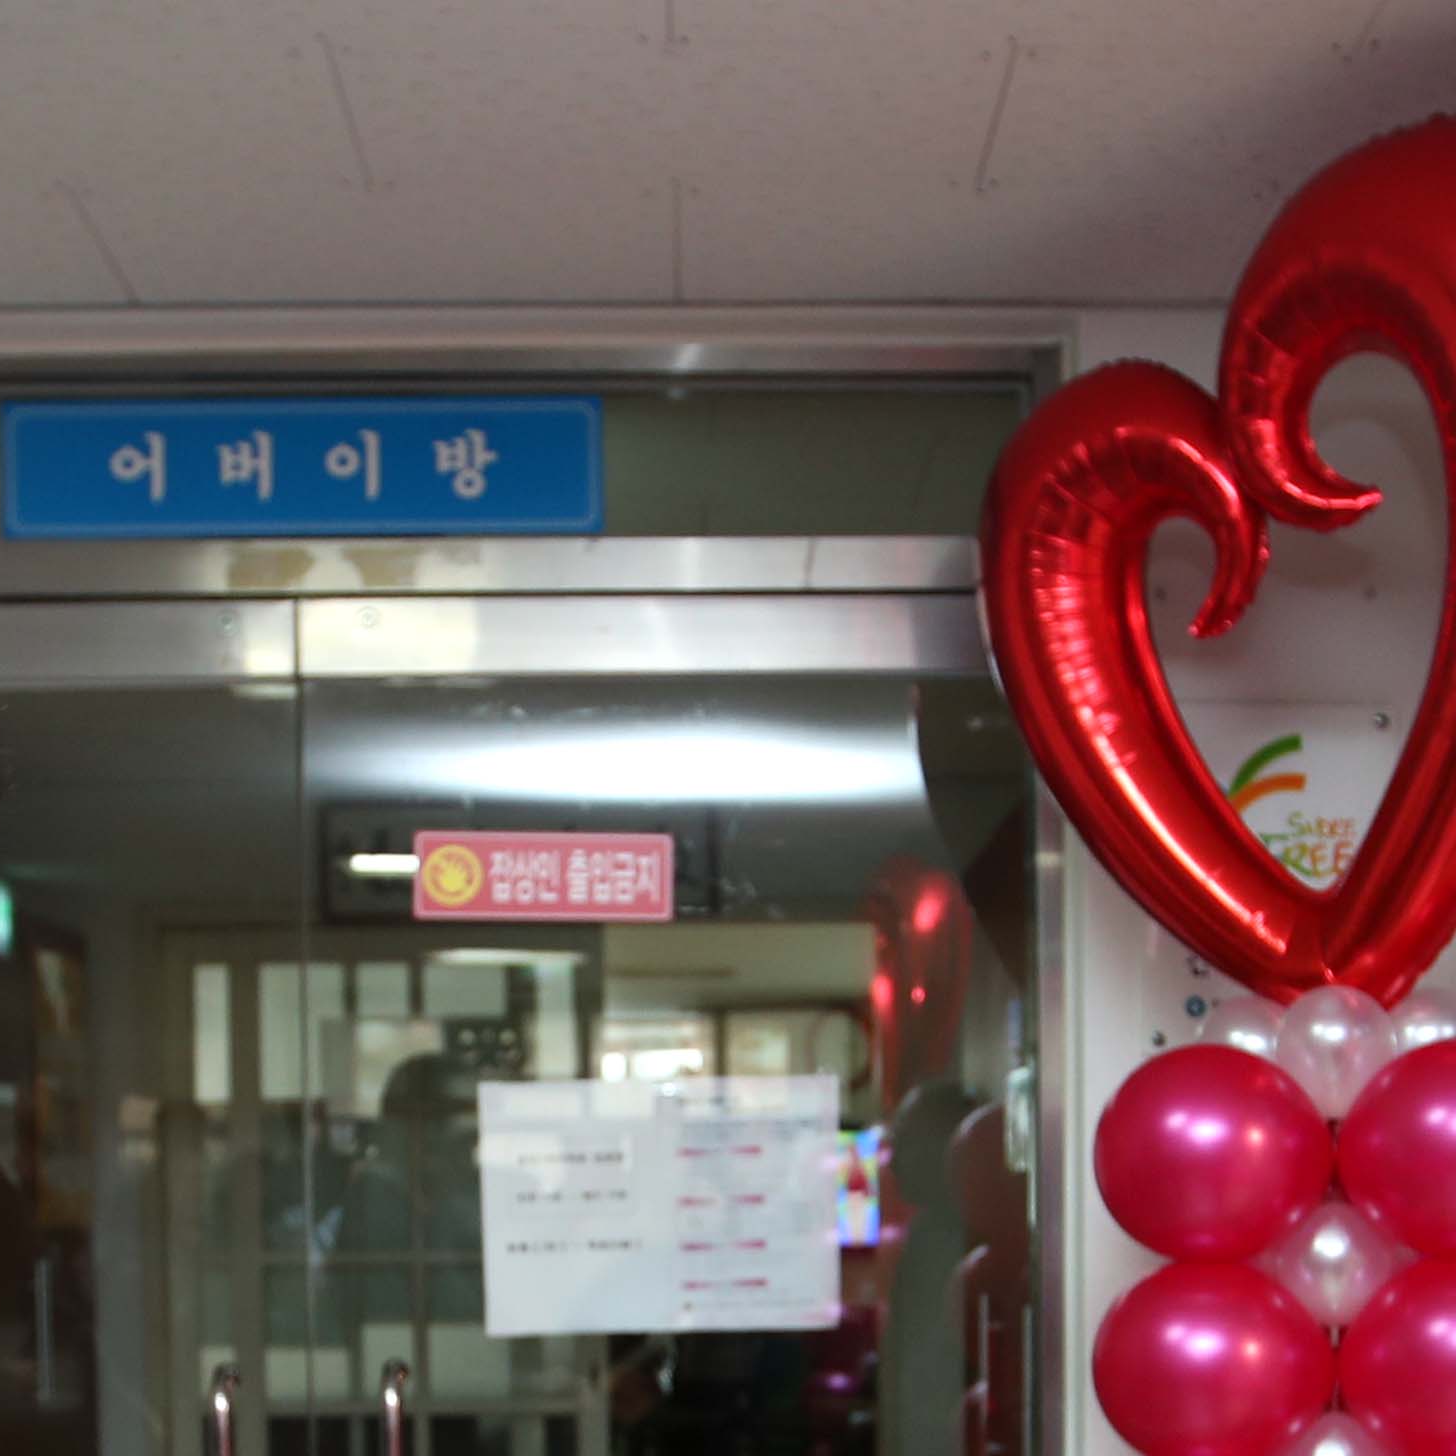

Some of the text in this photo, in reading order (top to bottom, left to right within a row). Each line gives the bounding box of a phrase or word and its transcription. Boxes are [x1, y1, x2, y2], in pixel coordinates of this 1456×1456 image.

[109, 429, 498, 502] 어버이방
[489, 848, 661, 904] 잡상인 출입금지
